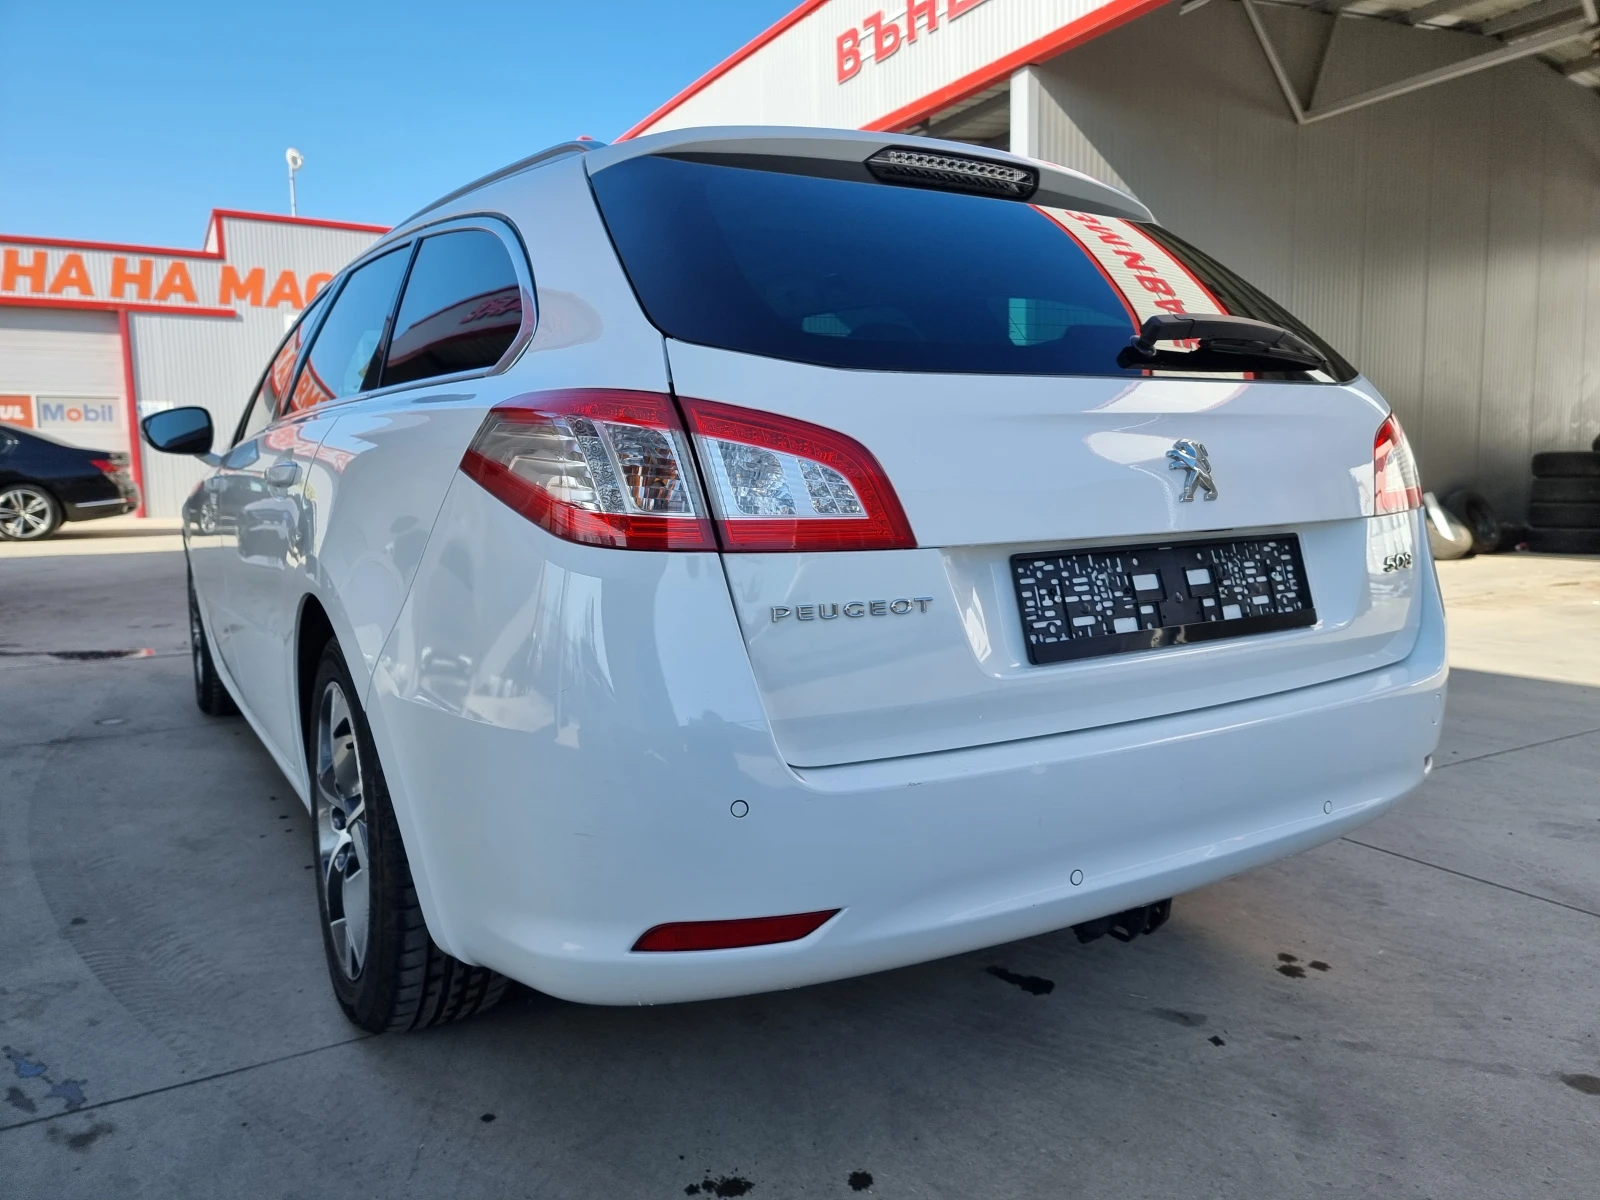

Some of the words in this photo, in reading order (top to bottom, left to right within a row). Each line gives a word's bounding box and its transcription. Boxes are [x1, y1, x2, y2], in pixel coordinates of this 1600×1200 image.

[110, 256, 199, 303] НА
[42, 403, 113, 422] Mobil
[1383, 552, 1411, 572] 508
[770, 596, 934, 623] PEUGEOT
